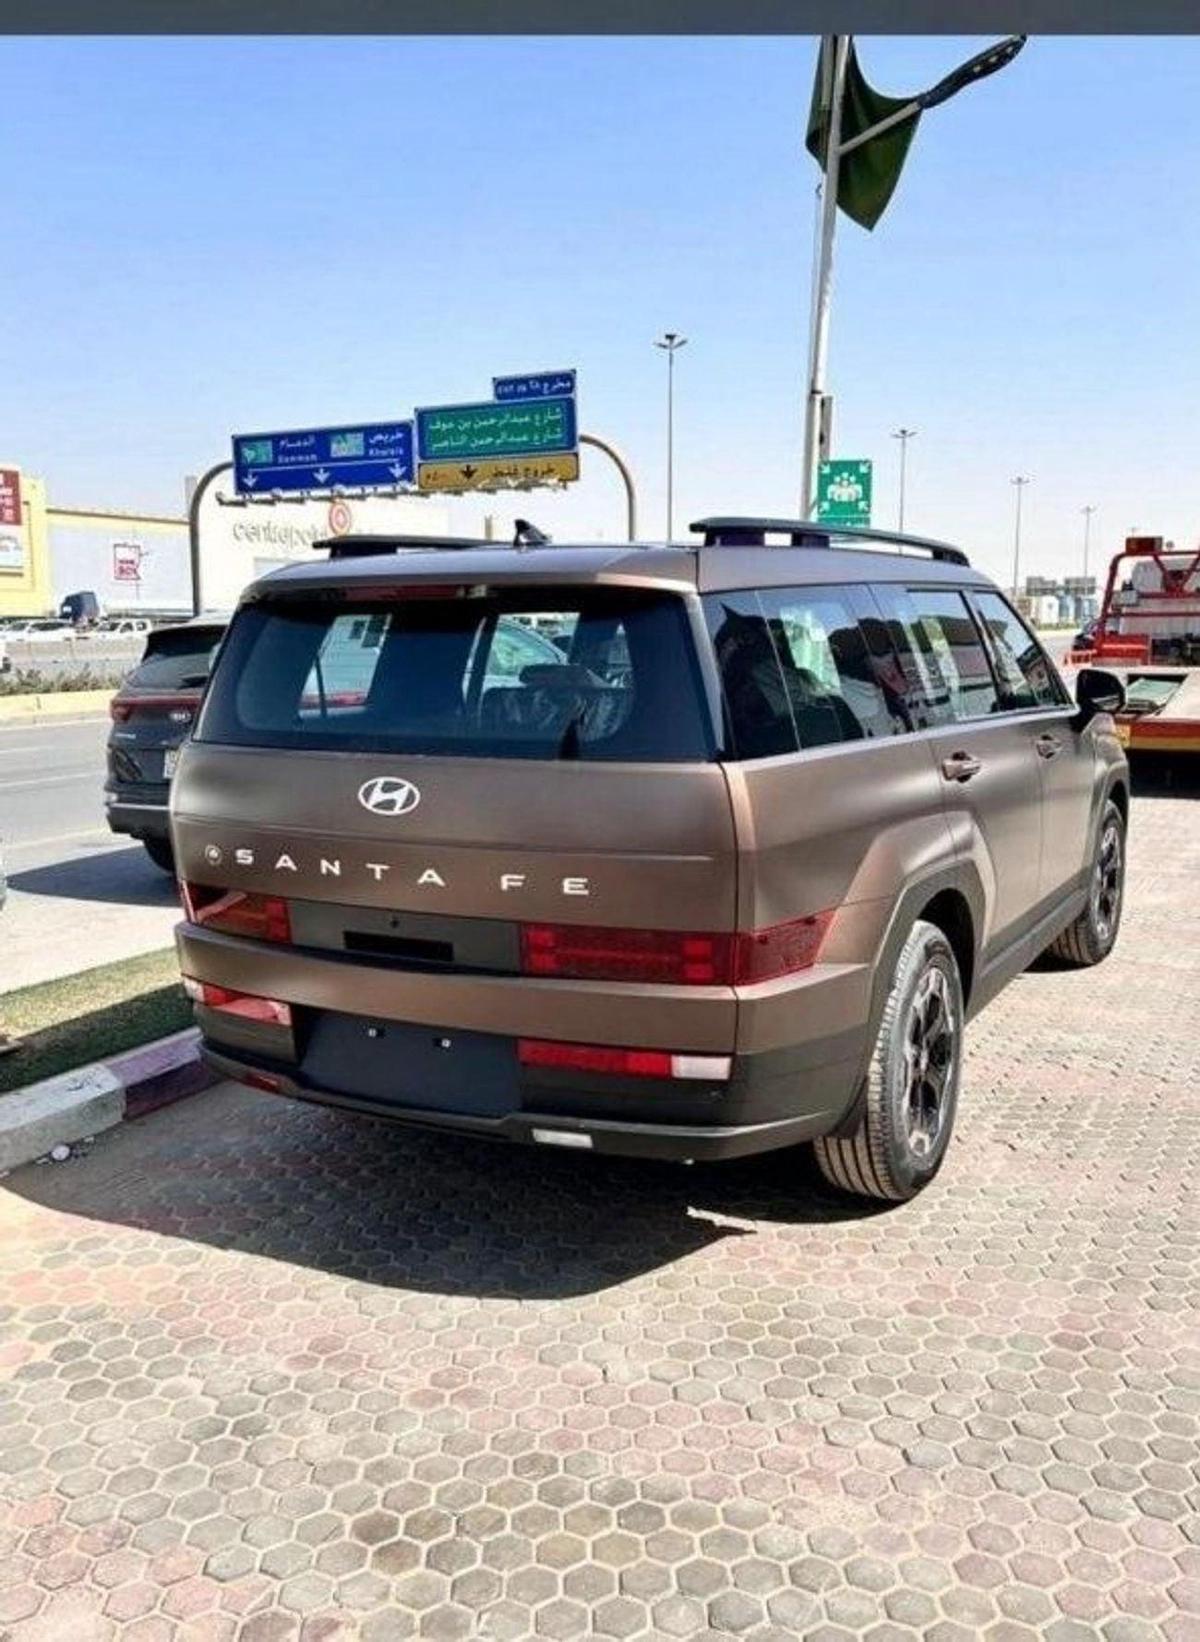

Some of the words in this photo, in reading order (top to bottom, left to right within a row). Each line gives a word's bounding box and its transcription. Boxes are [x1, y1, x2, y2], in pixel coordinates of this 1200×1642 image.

[534, 407, 562, 427] شارع
[533, 427, 562, 446] شارع
[235, 848, 445, 887] SANTA
[500, 873, 589, 896] FE
